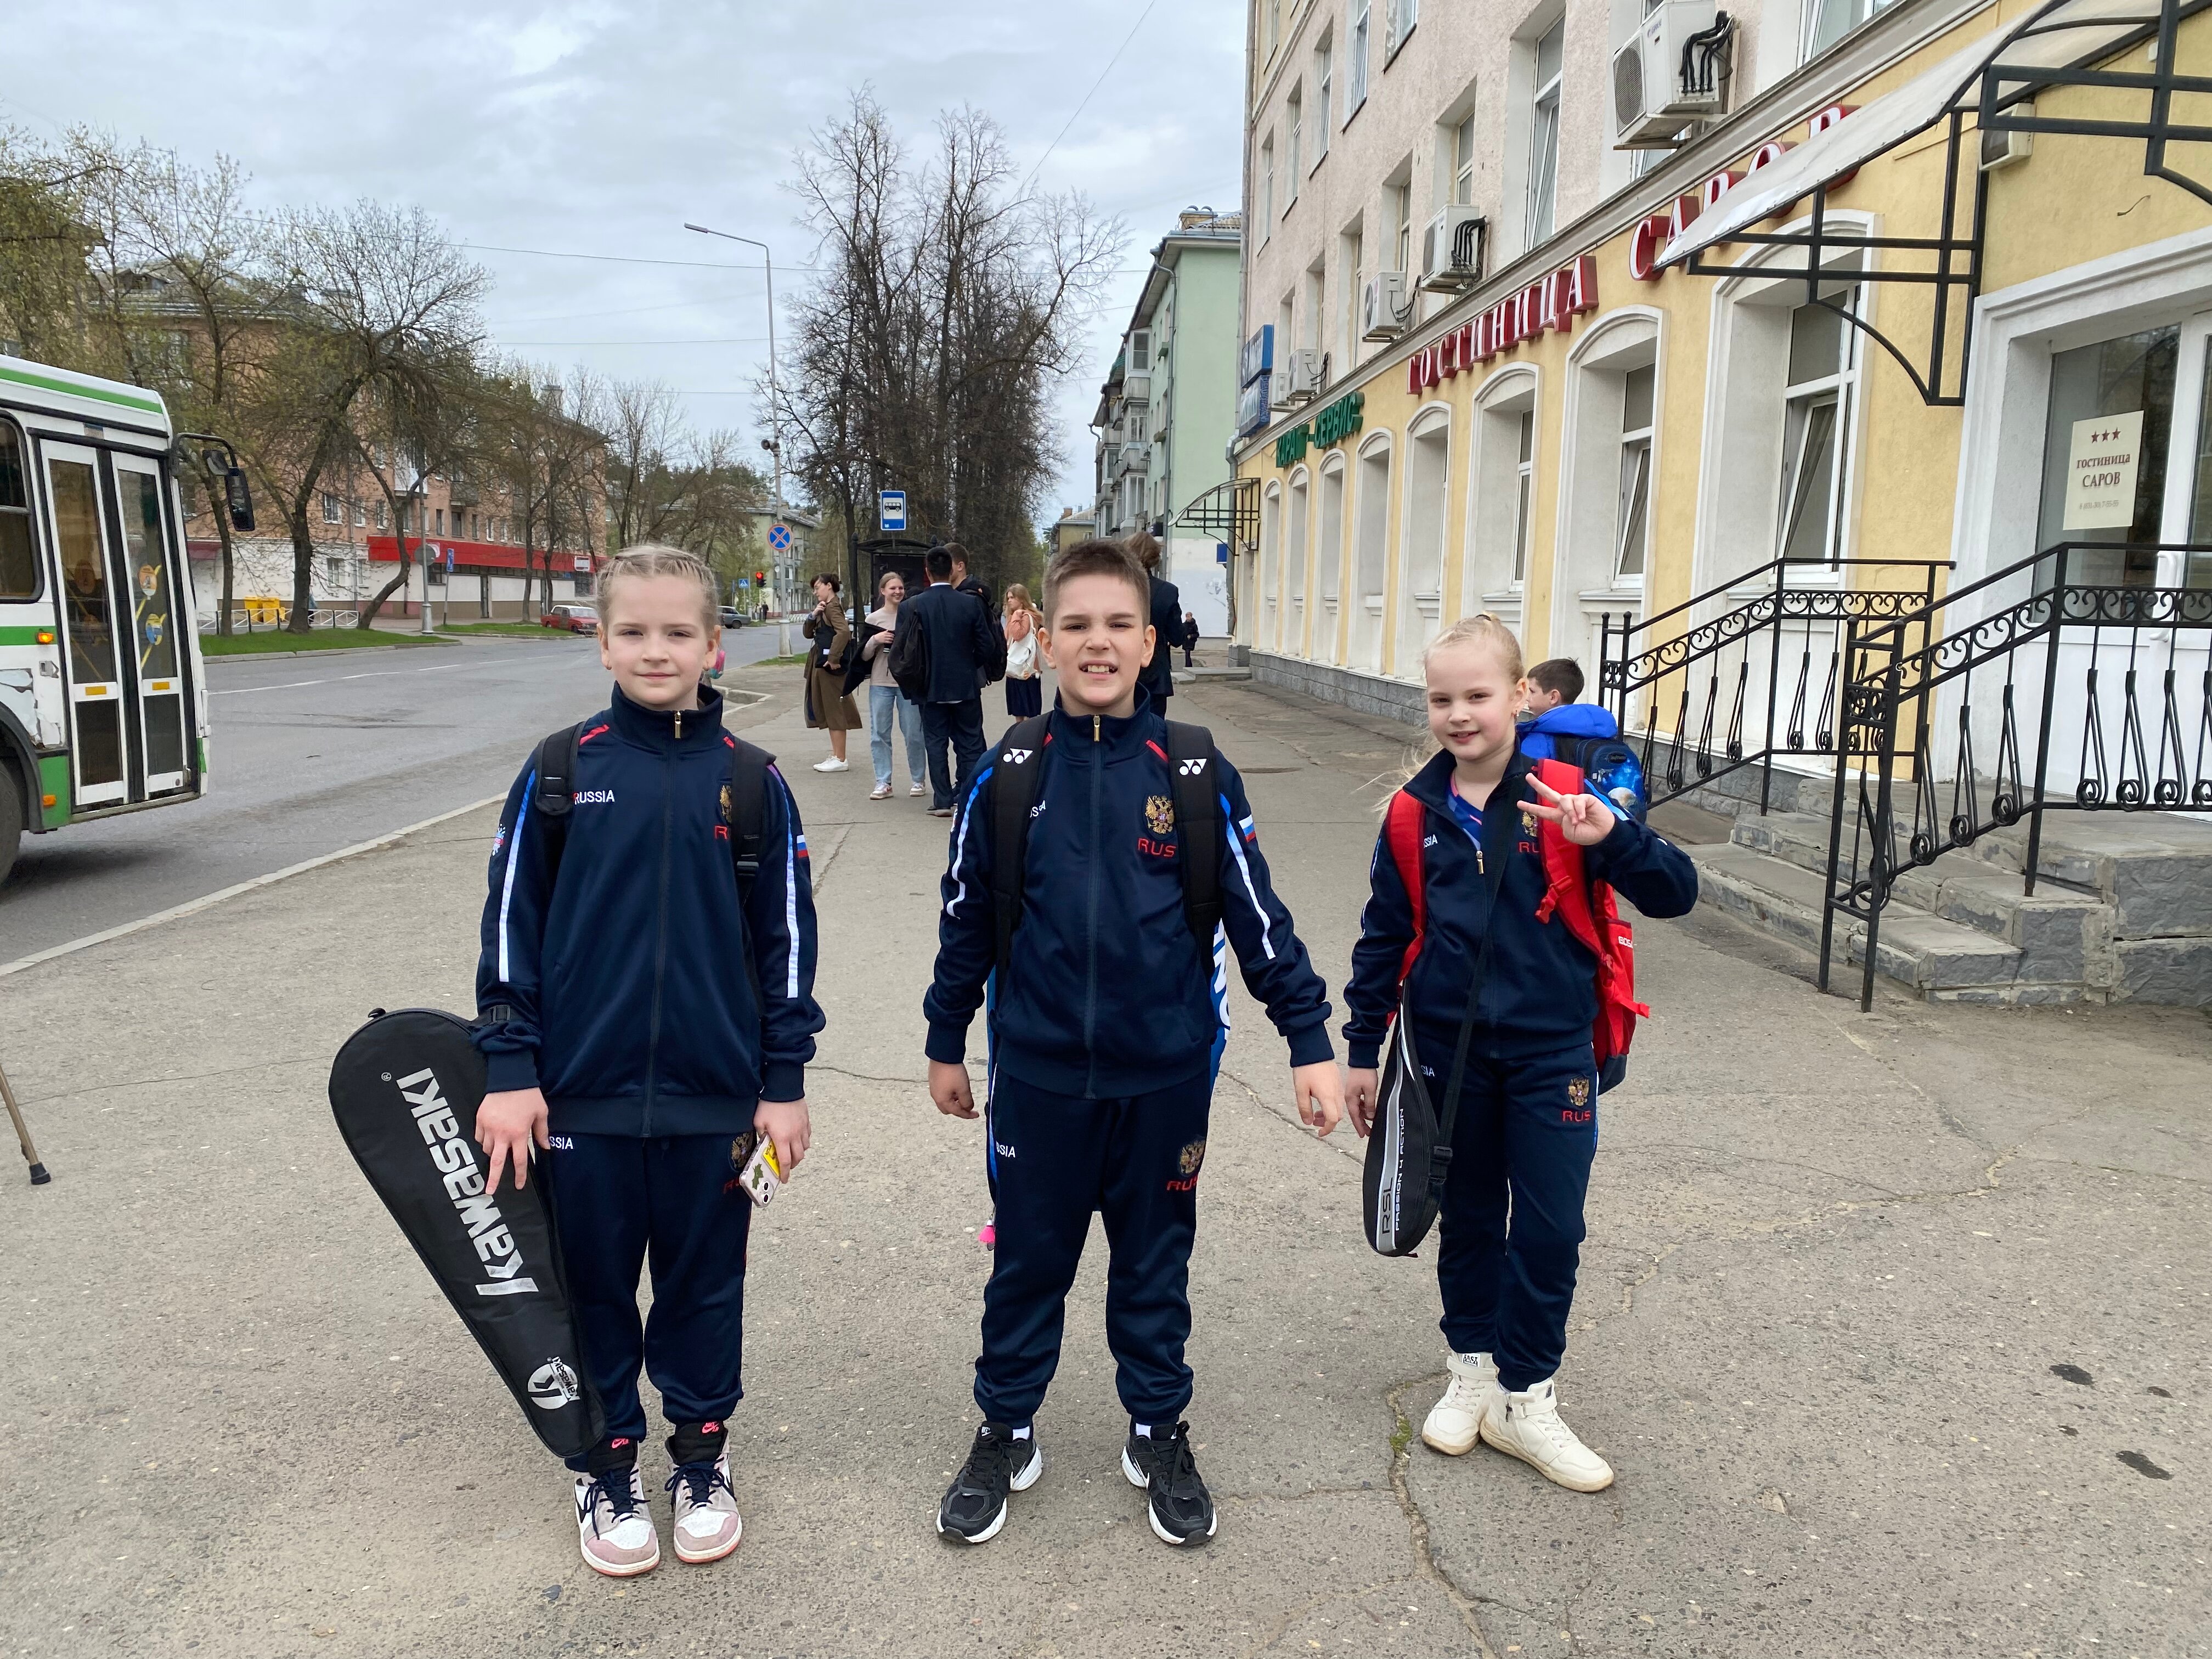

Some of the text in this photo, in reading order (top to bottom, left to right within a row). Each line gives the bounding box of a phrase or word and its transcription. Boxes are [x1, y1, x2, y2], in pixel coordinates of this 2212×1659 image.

[1407, 255, 1599, 395] ГОСТИНИЦА
[2083, 472, 2121, 487] САРОВ
[573, 790, 615, 805] RUSSIA
[1138, 838, 1177, 857] RUS
[1563, 1110, 1590, 1122] RUS
[1399, 1159, 1404, 1169] 4
[1382, 1177, 1393, 1234] RSL
